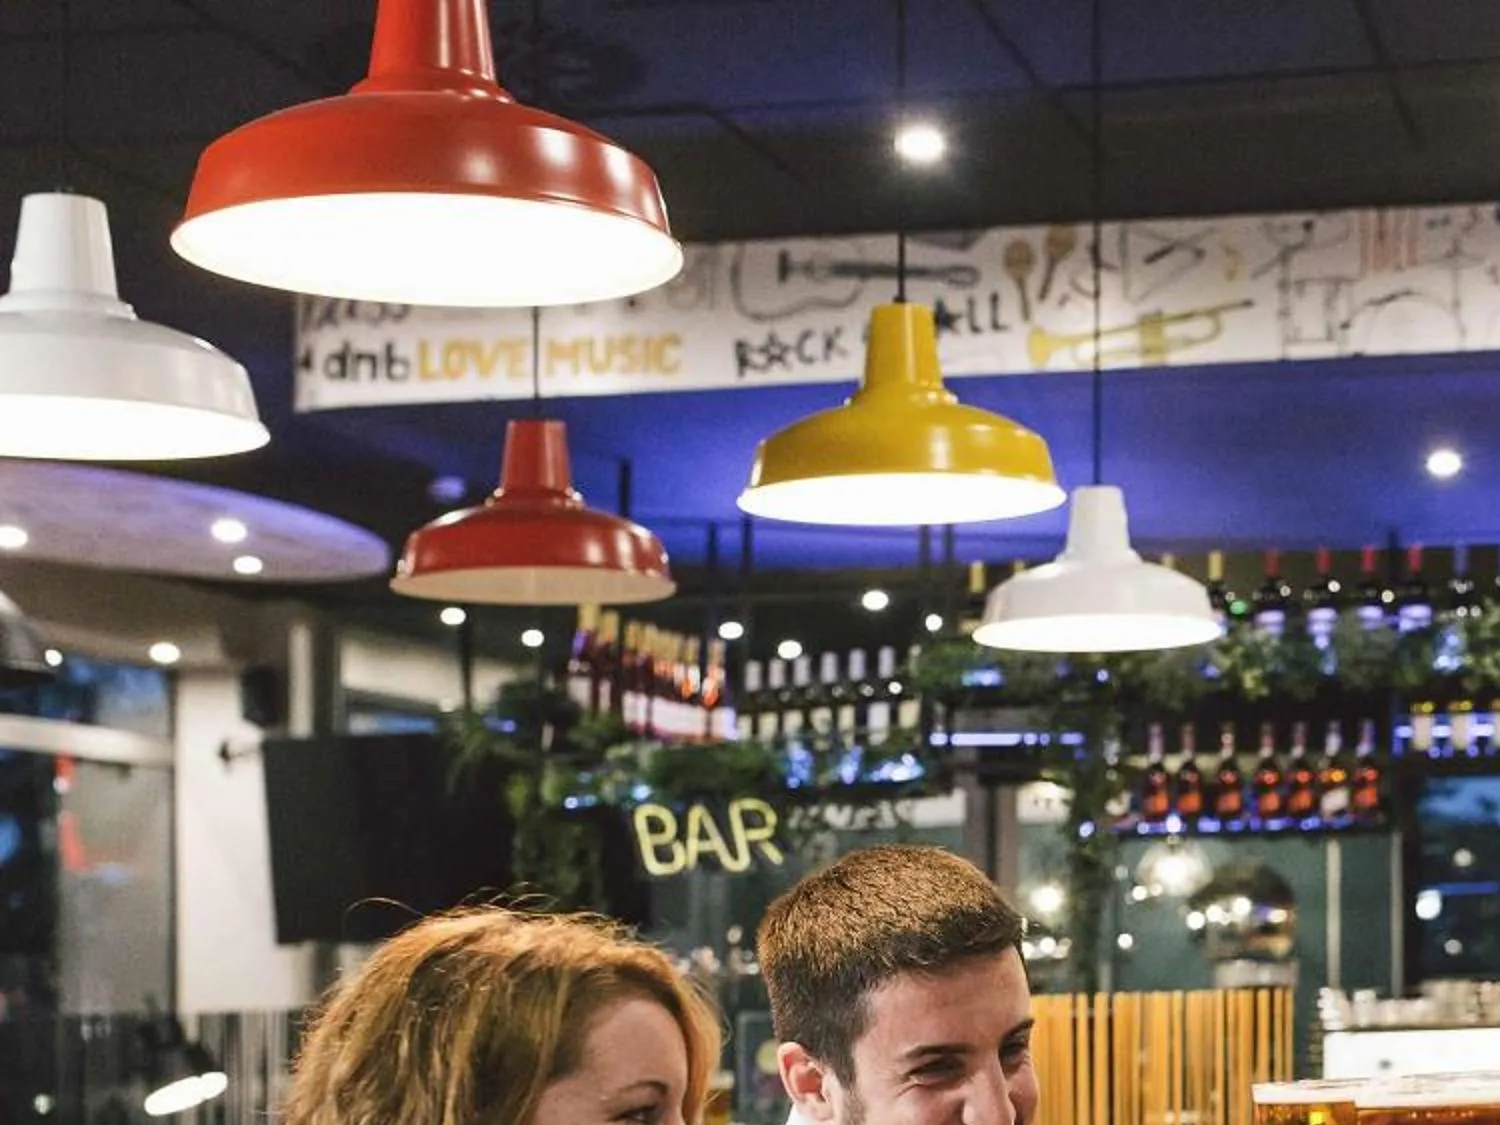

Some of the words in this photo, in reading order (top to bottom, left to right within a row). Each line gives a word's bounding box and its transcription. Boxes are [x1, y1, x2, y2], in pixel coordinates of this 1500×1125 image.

[418, 336, 527, 383] LOVE
[546, 331, 684, 378] MUSIC
[634, 797, 784, 876] BAR
